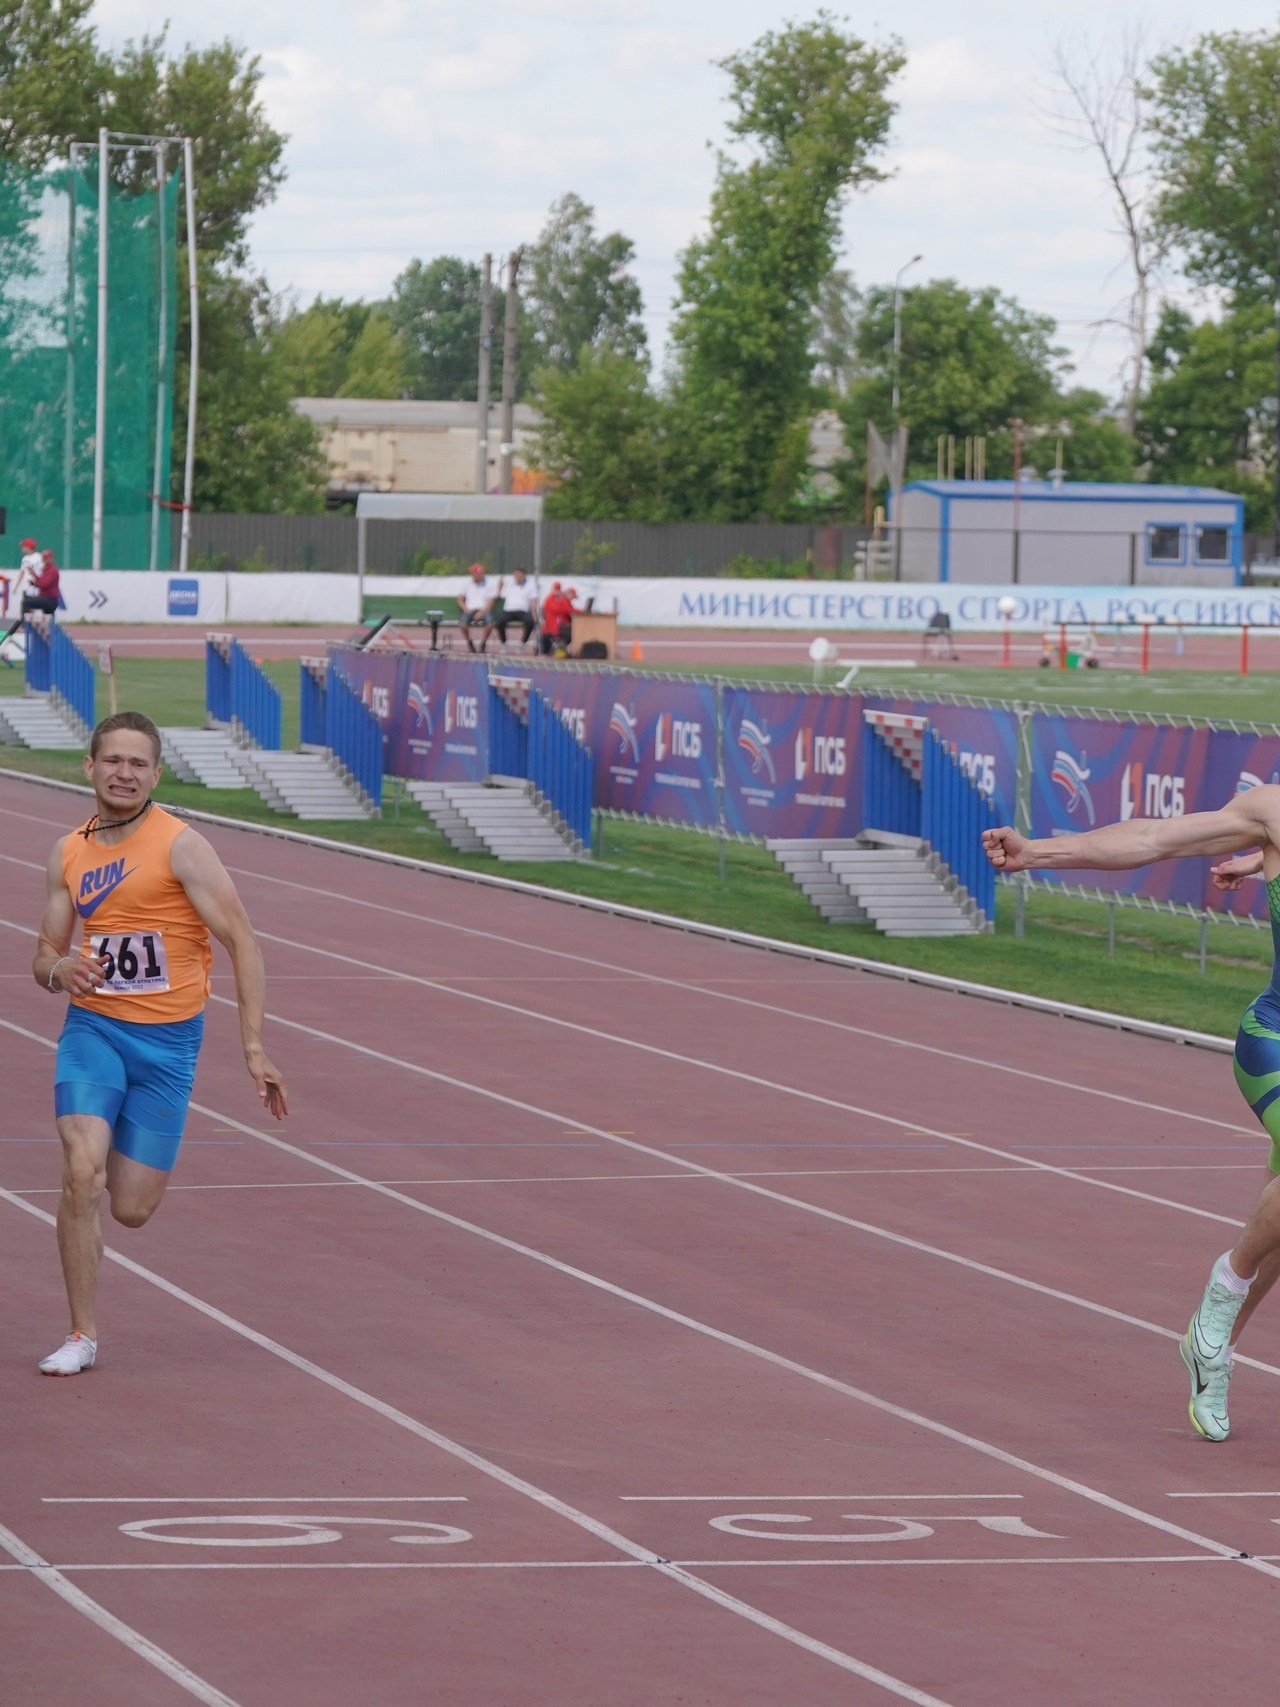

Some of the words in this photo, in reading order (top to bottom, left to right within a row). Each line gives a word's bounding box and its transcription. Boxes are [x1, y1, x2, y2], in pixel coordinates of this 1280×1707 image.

[679, 592, 940, 620] МИНИСТЕРСТВО
[958, 596, 1088, 623] СПОРТА
[456, 695, 478, 729] ПСБ
[671, 720, 701, 759] ПСБ
[814, 735, 846, 776] ПСБ
[1145, 773, 1185, 819] ПСБ
[80, 858, 125, 898] RUN
[99, 936, 161, 980] 661
